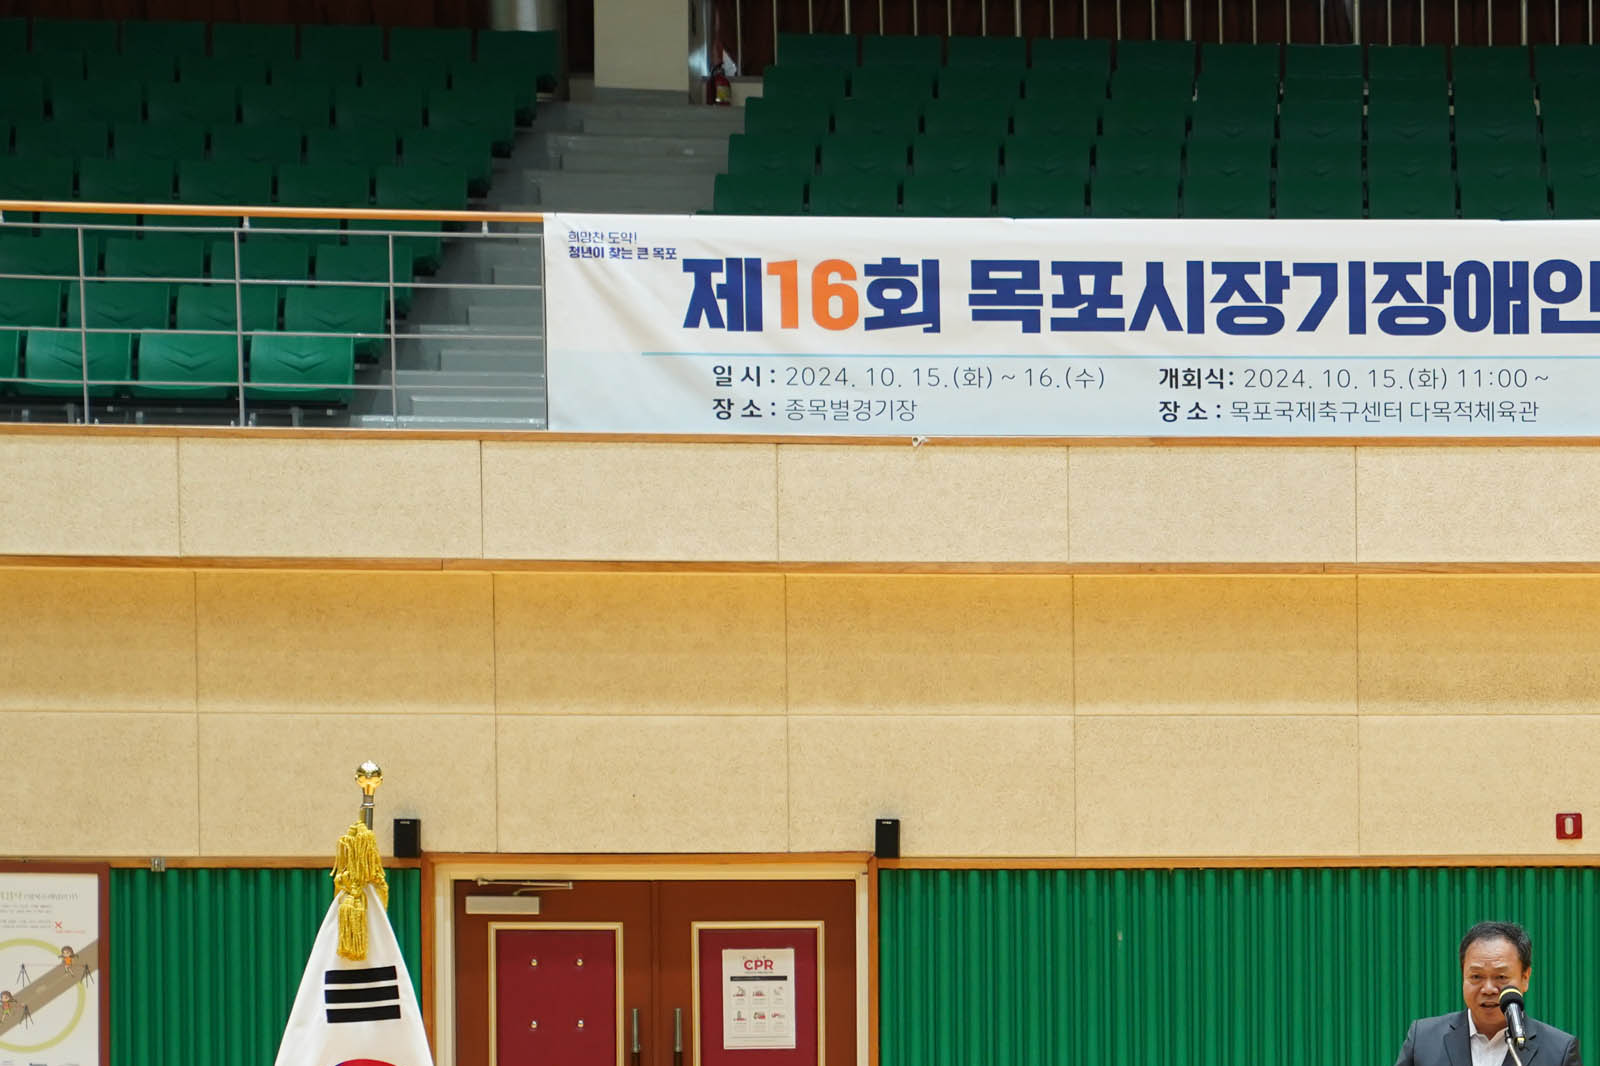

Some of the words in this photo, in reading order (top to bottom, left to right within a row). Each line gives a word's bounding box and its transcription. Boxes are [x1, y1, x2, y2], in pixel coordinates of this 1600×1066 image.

[568, 246, 605, 259] 청년이
[609, 247, 633, 260] 찾는
[637, 247, 649, 260] 큰
[653, 247, 678, 260] 목포
[683, 257, 941, 334] 제16회
[785, 398, 918, 421] 종목별경기장
[1230, 401, 1403, 423] 목포국제축구센터
[1410, 400, 1539, 423] 다목적체육관
[744, 959, 774, 971] CPR
